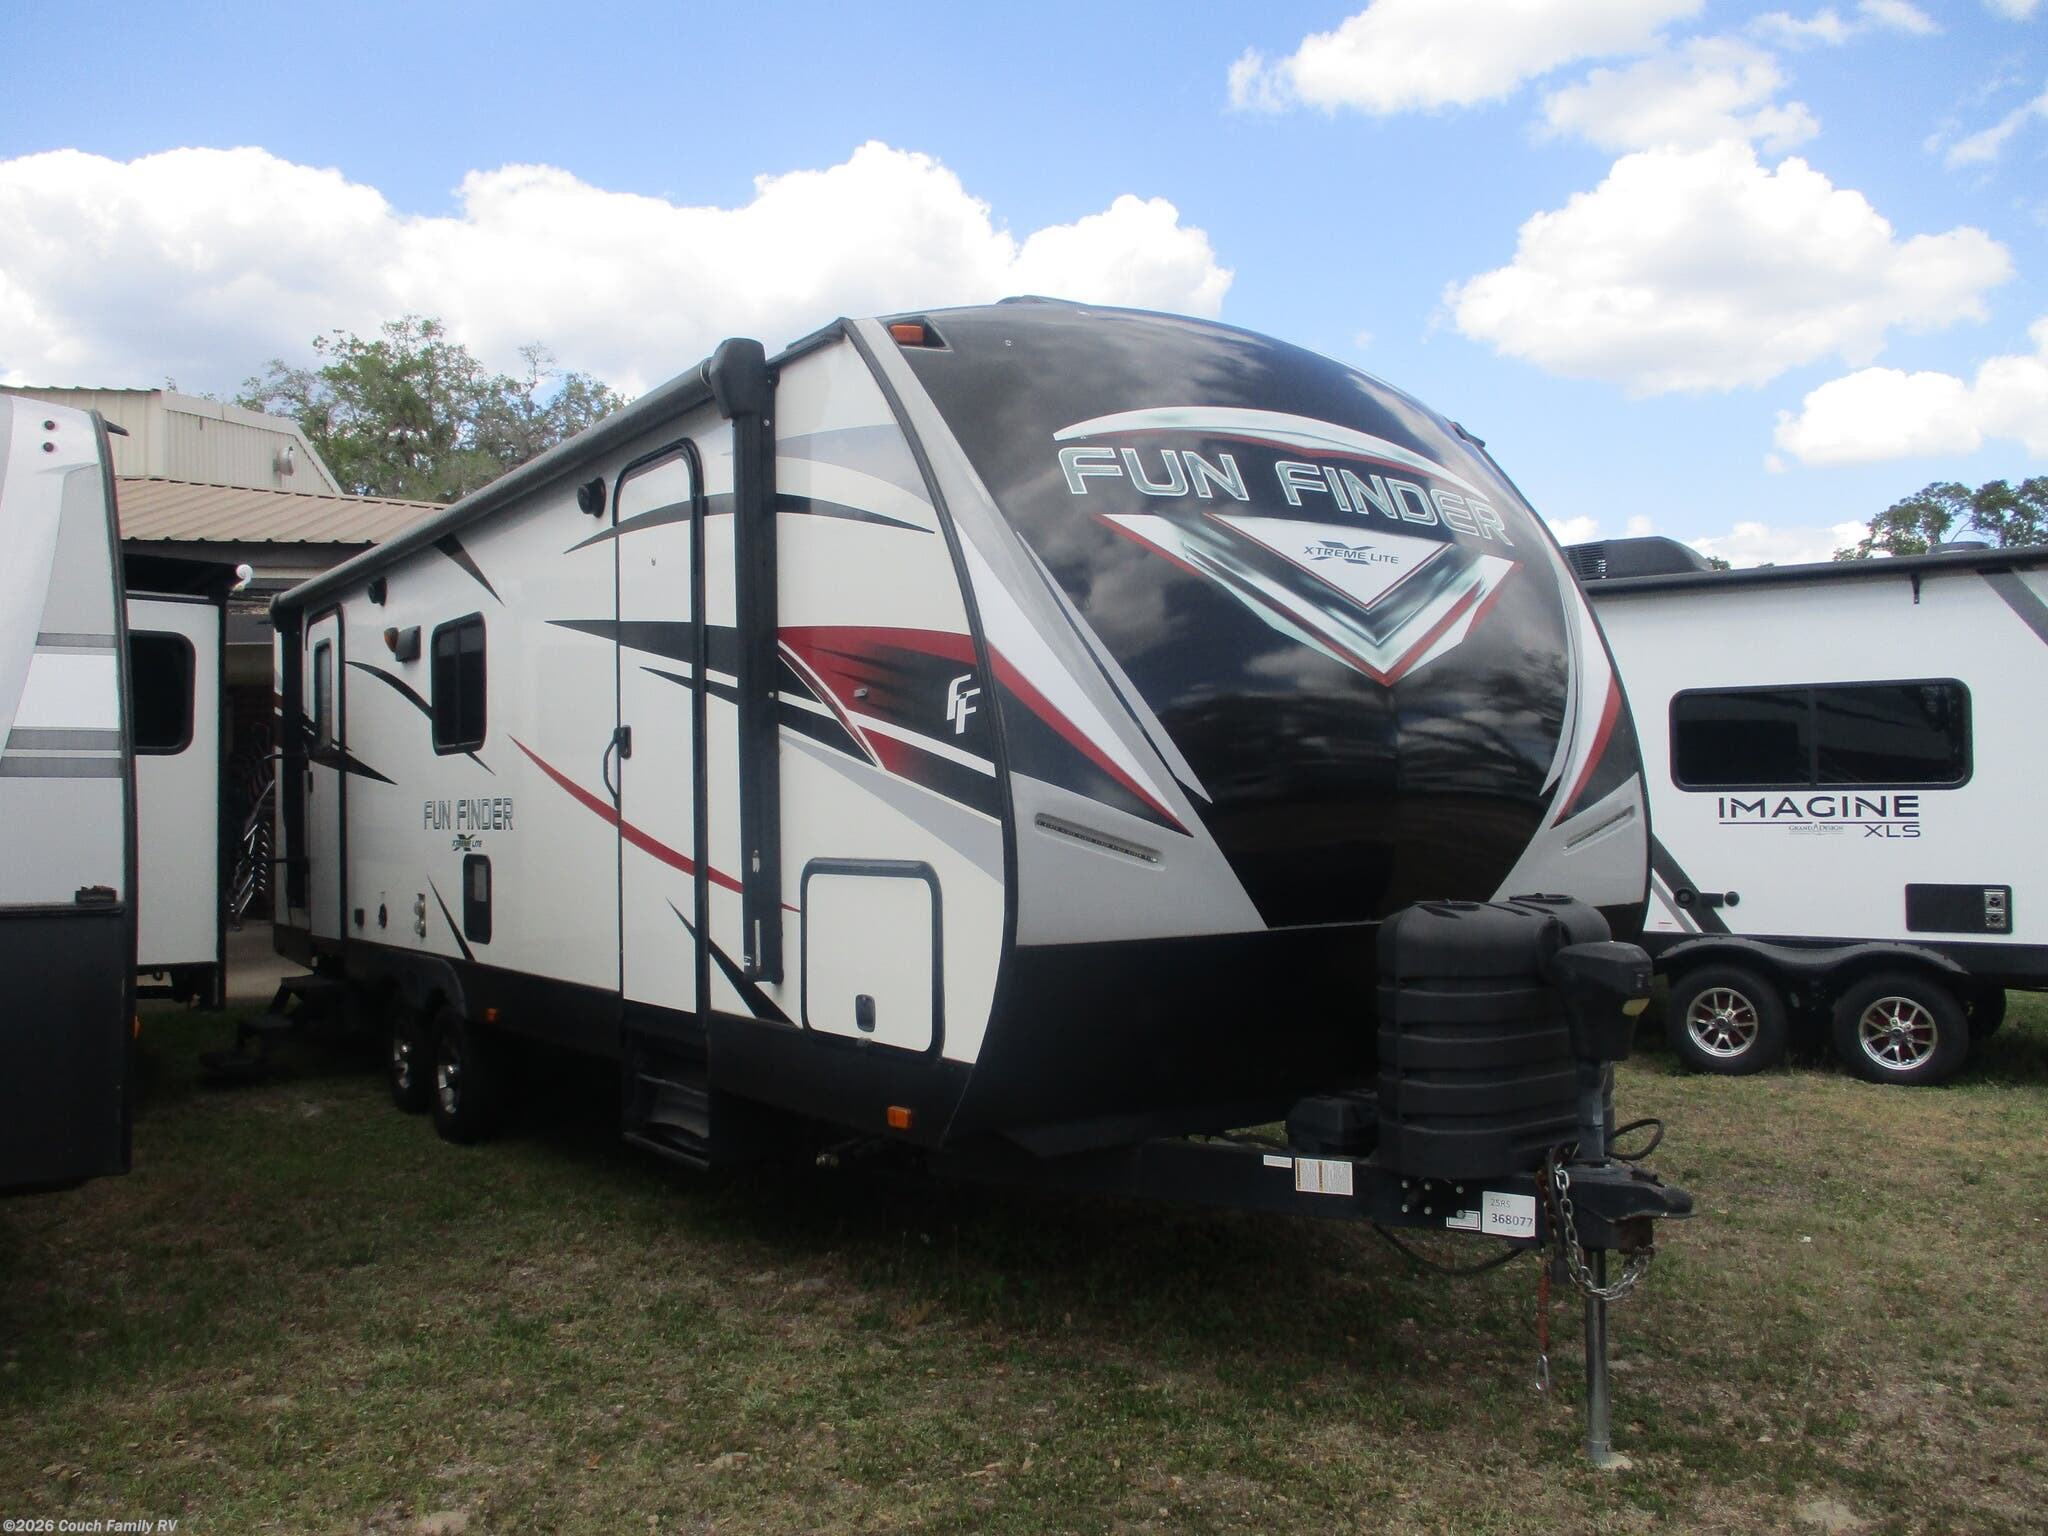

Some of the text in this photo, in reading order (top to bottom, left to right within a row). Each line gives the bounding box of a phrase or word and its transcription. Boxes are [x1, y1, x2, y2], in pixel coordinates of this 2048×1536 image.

[1057, 446, 1514, 547] FUN FINDER
[1303, 545, 1399, 564] XTREME LITE
[424, 798, 514, 831] FUN FINDER
[1718, 795, 1919, 819] IMAGINE
[1864, 824, 1921, 838] XLS
[1491, 1213, 1533, 1228] 368077
